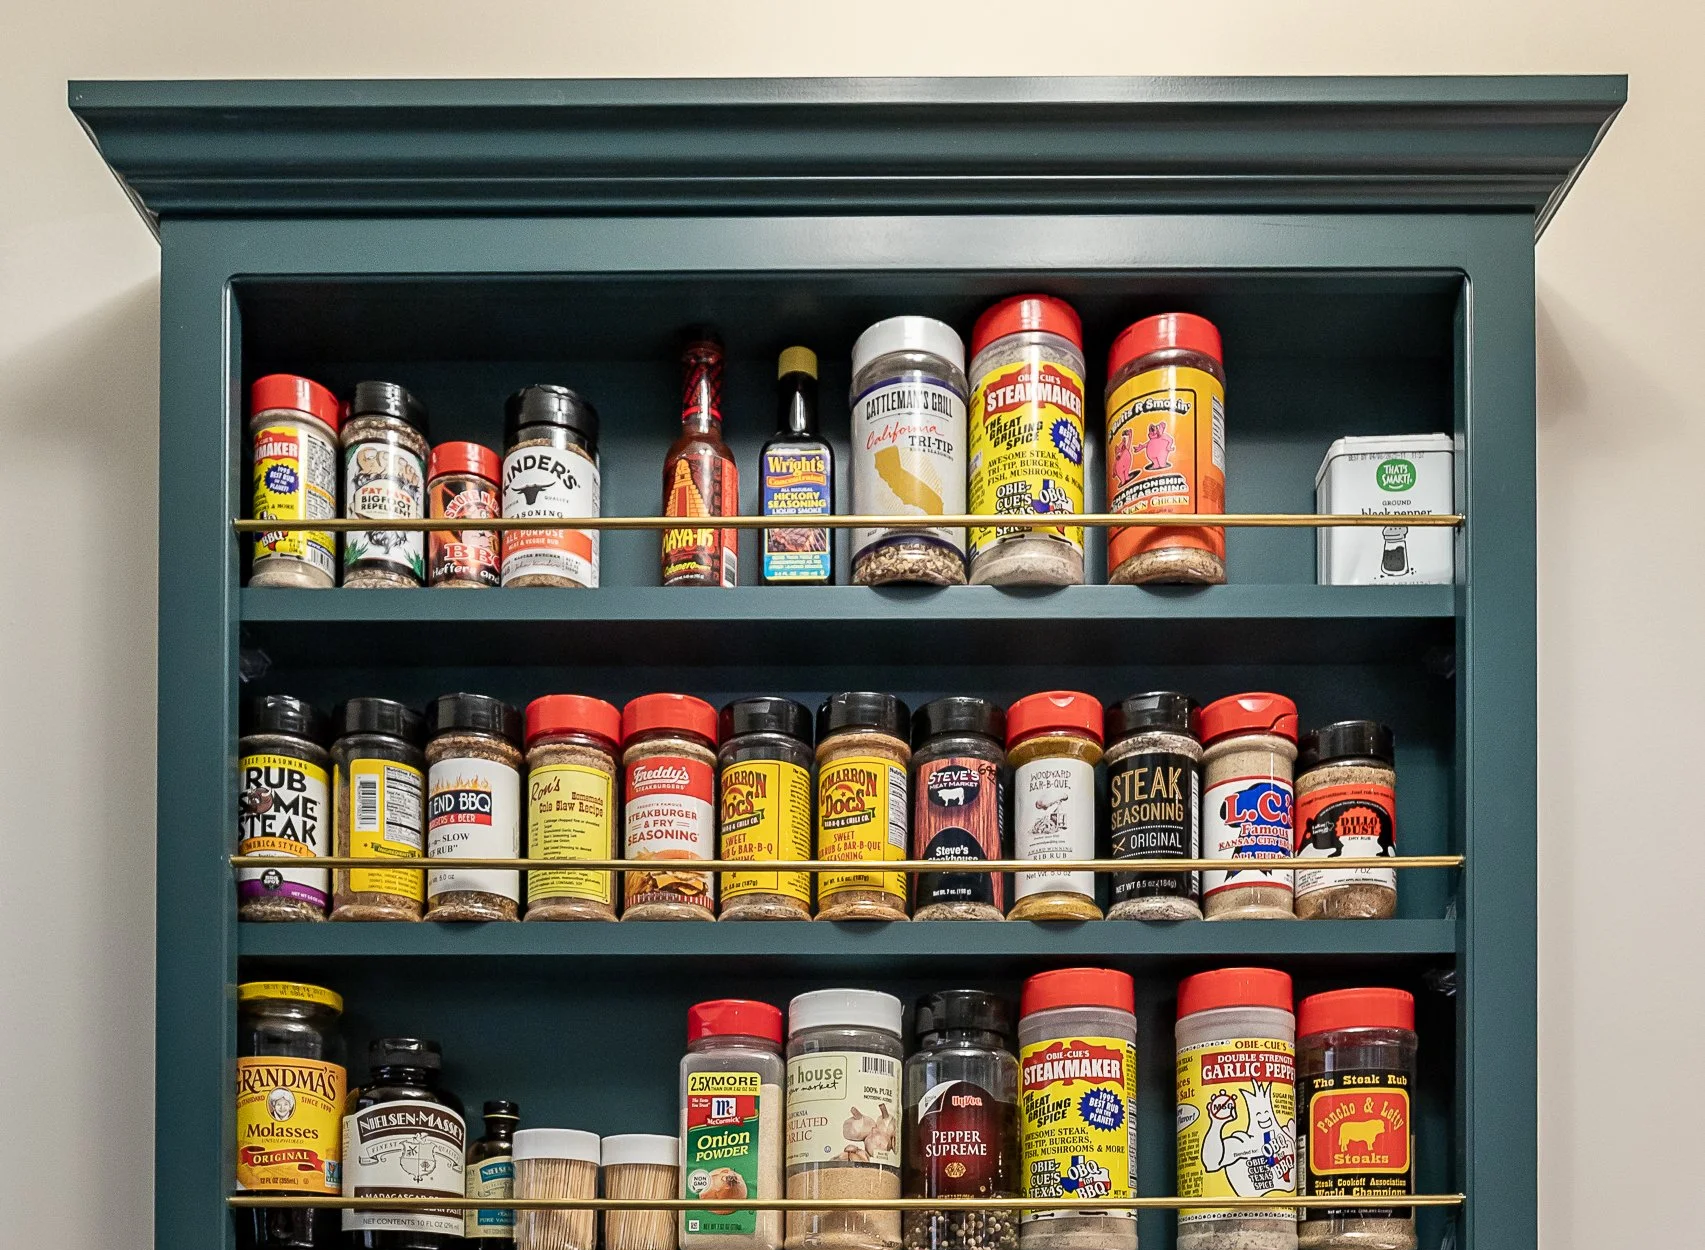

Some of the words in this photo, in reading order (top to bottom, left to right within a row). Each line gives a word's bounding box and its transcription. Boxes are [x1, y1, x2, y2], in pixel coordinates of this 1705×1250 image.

[931, 392, 953, 418] GRILL
[987, 383, 1082, 418] STEAKMAKER
[866, 421, 945, 450] California
[989, 416, 1021, 441] GREAT
[993, 421, 1044, 449] GRILLING
[908, 435, 954, 452] TRI-TIP
[1006, 433, 1040, 451] SPICE
[767, 456, 826, 476] Wright's
[988, 450, 1026, 468] AWESOME
[1029, 450, 1059, 460] STEAK,
[1009, 467, 1063, 481] MUSHROOMS
[1383, 464, 1408, 475] THAT'S
[1382, 474, 1411, 487] SMART!
[773, 492, 820, 501] HICKORY
[995, 481, 1031, 498] OBIE-
[1039, 485, 1067, 504] OBQ
[768, 499, 827, 509] SEASONING
[995, 494, 1032, 511] CUE'S
[1151, 497, 1188, 506] CHICKEN
[261, 531, 284, 546] BBQ
[520, 529, 563, 539] PURPOSE
[245, 766, 307, 792] RUB
[632, 766, 690, 786] Freddy's
[928, 771, 980, 786] STEVE'S
[1030, 770, 1072, 781] WOODYARD
[531, 776, 561, 807] Ron's
[1112, 766, 1183, 809] STEAK
[434, 796, 455, 813] END
[459, 794, 492, 812] BBQ
[571, 792, 604, 806] Homemade
[539, 801, 554, 814] Cole
[556, 801, 577, 813] Slaw
[579, 803, 604, 818] Recipe
[628, 808, 698, 825] STEAKBURGER
[1111, 802, 1184, 831] SEASONING
[457, 814, 476, 823] BEER
[1340, 815, 1379, 827] DILLO
[442, 832, 471, 843] SLOW
[627, 830, 698, 847] SEASONING
[833, 831, 855, 843] SWEET
[1342, 825, 1376, 836] DUST
[725, 833, 747, 848] SWEET
[1130, 832, 1182, 850] ORIGINAL
[1218, 837, 1256, 851] KANSAS
[1257, 836, 1279, 846] CITY
[935, 845, 969, 857] Steve's
[1234, 1039, 1288, 1052] OBIE-CUE'S
[1045, 1049, 1091, 1061] OBIE-CUE'S
[1217, 1053, 1259, 1064] DOUBLE
[797, 1066, 844, 1084] house
[1024, 1057, 1122, 1086] STEAKMAKER
[1202, 1062, 1262, 1080] GARLIC
[711, 1075, 759, 1086] MORE
[803, 1080, 840, 1094] market
[1026, 1094, 1051, 1116] GREAT
[1027, 1097, 1072, 1123] GRILLING
[1036, 1110, 1068, 1129] SPICE
[1316, 1101, 1356, 1134] Pancho
[1363, 1097, 1375, 1113] &
[1380, 1101, 1405, 1131] Lofty
[246, 1121, 320, 1141] Molasses
[932, 1130, 982, 1143] PEPPER
[697, 1130, 751, 1150] Onion
[252, 1150, 311, 1165] ORIGINAL
[695, 1145, 750, 1162] POWDER
[925, 1142, 988, 1157] SUPREME
[1030, 1159, 1061, 1175] OBIE-
[1333, 1152, 1390, 1166] Steaks
[1067, 1160, 1101, 1180] OBQ
[1029, 1170, 1061, 1188] CUE'S
[1029, 1184, 1064, 1199] TEXAS
[1077, 1180, 1109, 1199] BBQ
